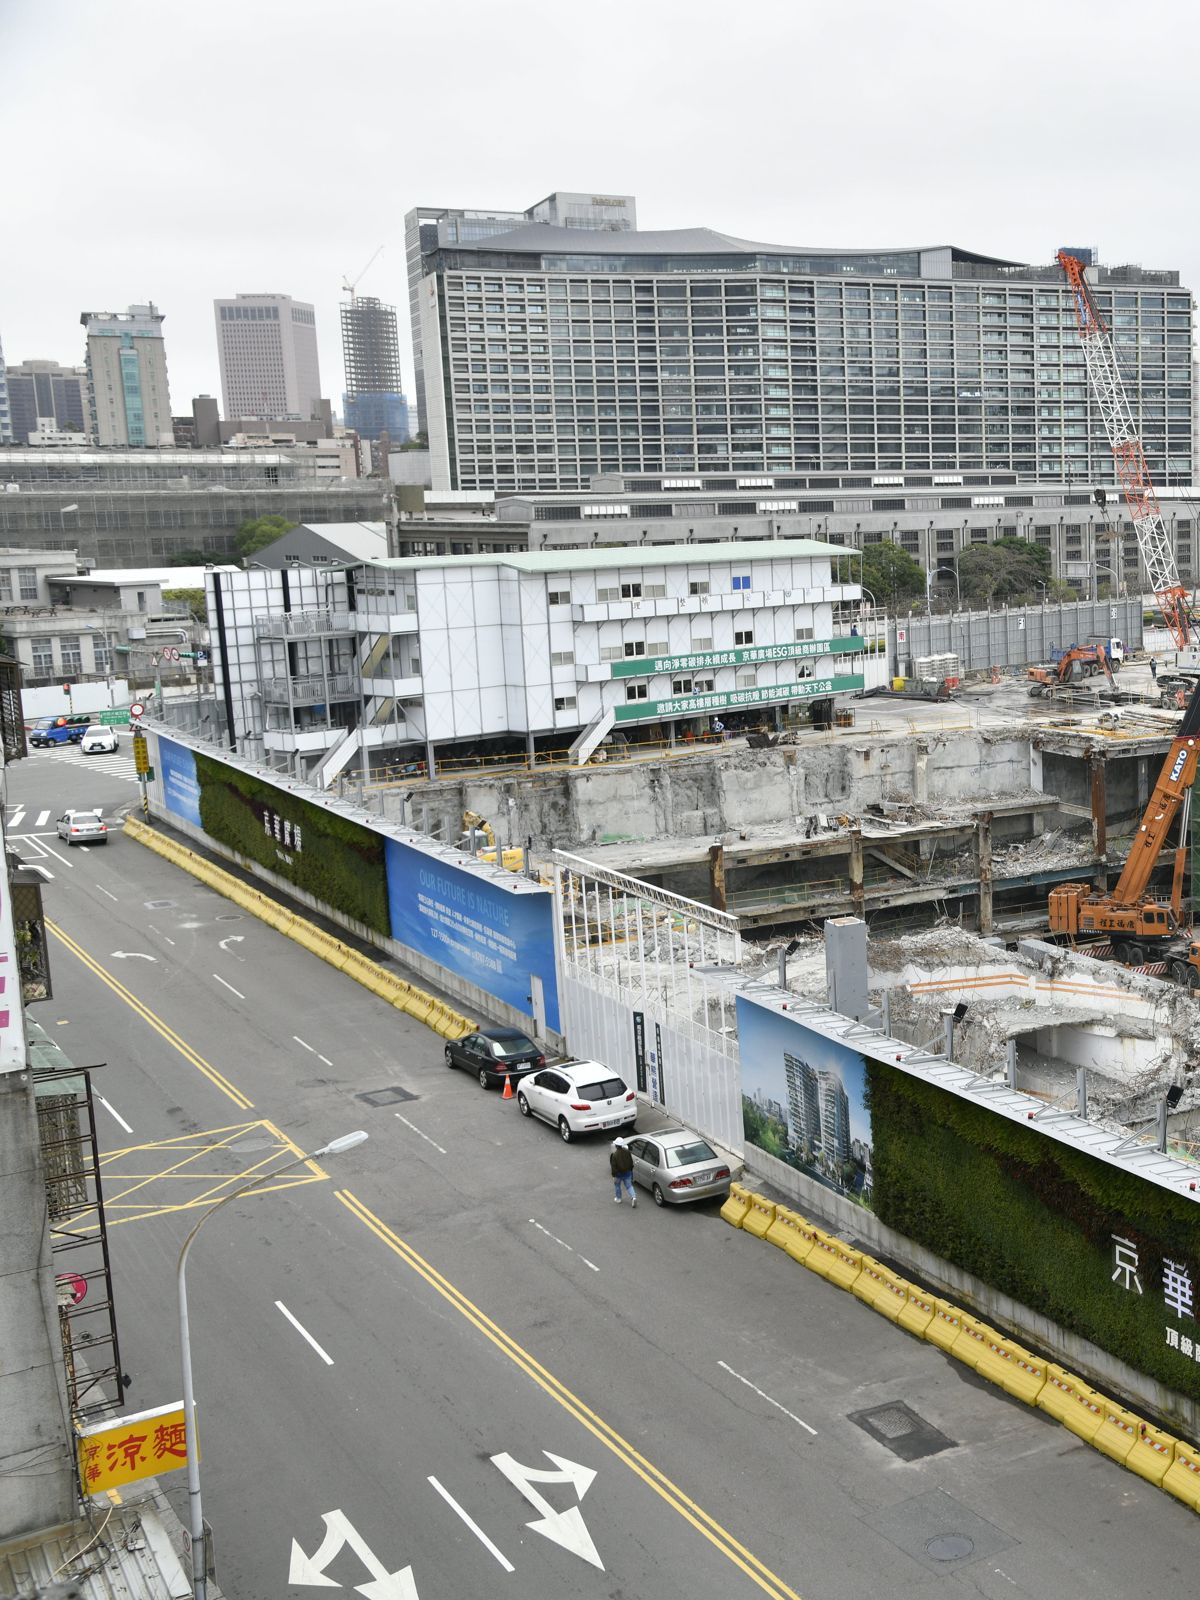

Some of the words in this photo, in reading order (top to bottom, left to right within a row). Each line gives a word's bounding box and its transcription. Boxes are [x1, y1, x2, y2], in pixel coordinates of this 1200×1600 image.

[654, 652, 737, 671] 邁向淨零碳排永續成長
[742, 642, 831, 662] 京華廣場ESG頂級商辦園區
[1169, 750, 1188, 782] KATO
[419, 869, 437, 892] OUR
[437, 876, 466, 906] FUTURE
[467, 891, 475, 910] IS
[476, 896, 510, 928] NATURE
[84, 1445, 102, 1482] 京華
[106, 1423, 188, 1473] 涼麵
